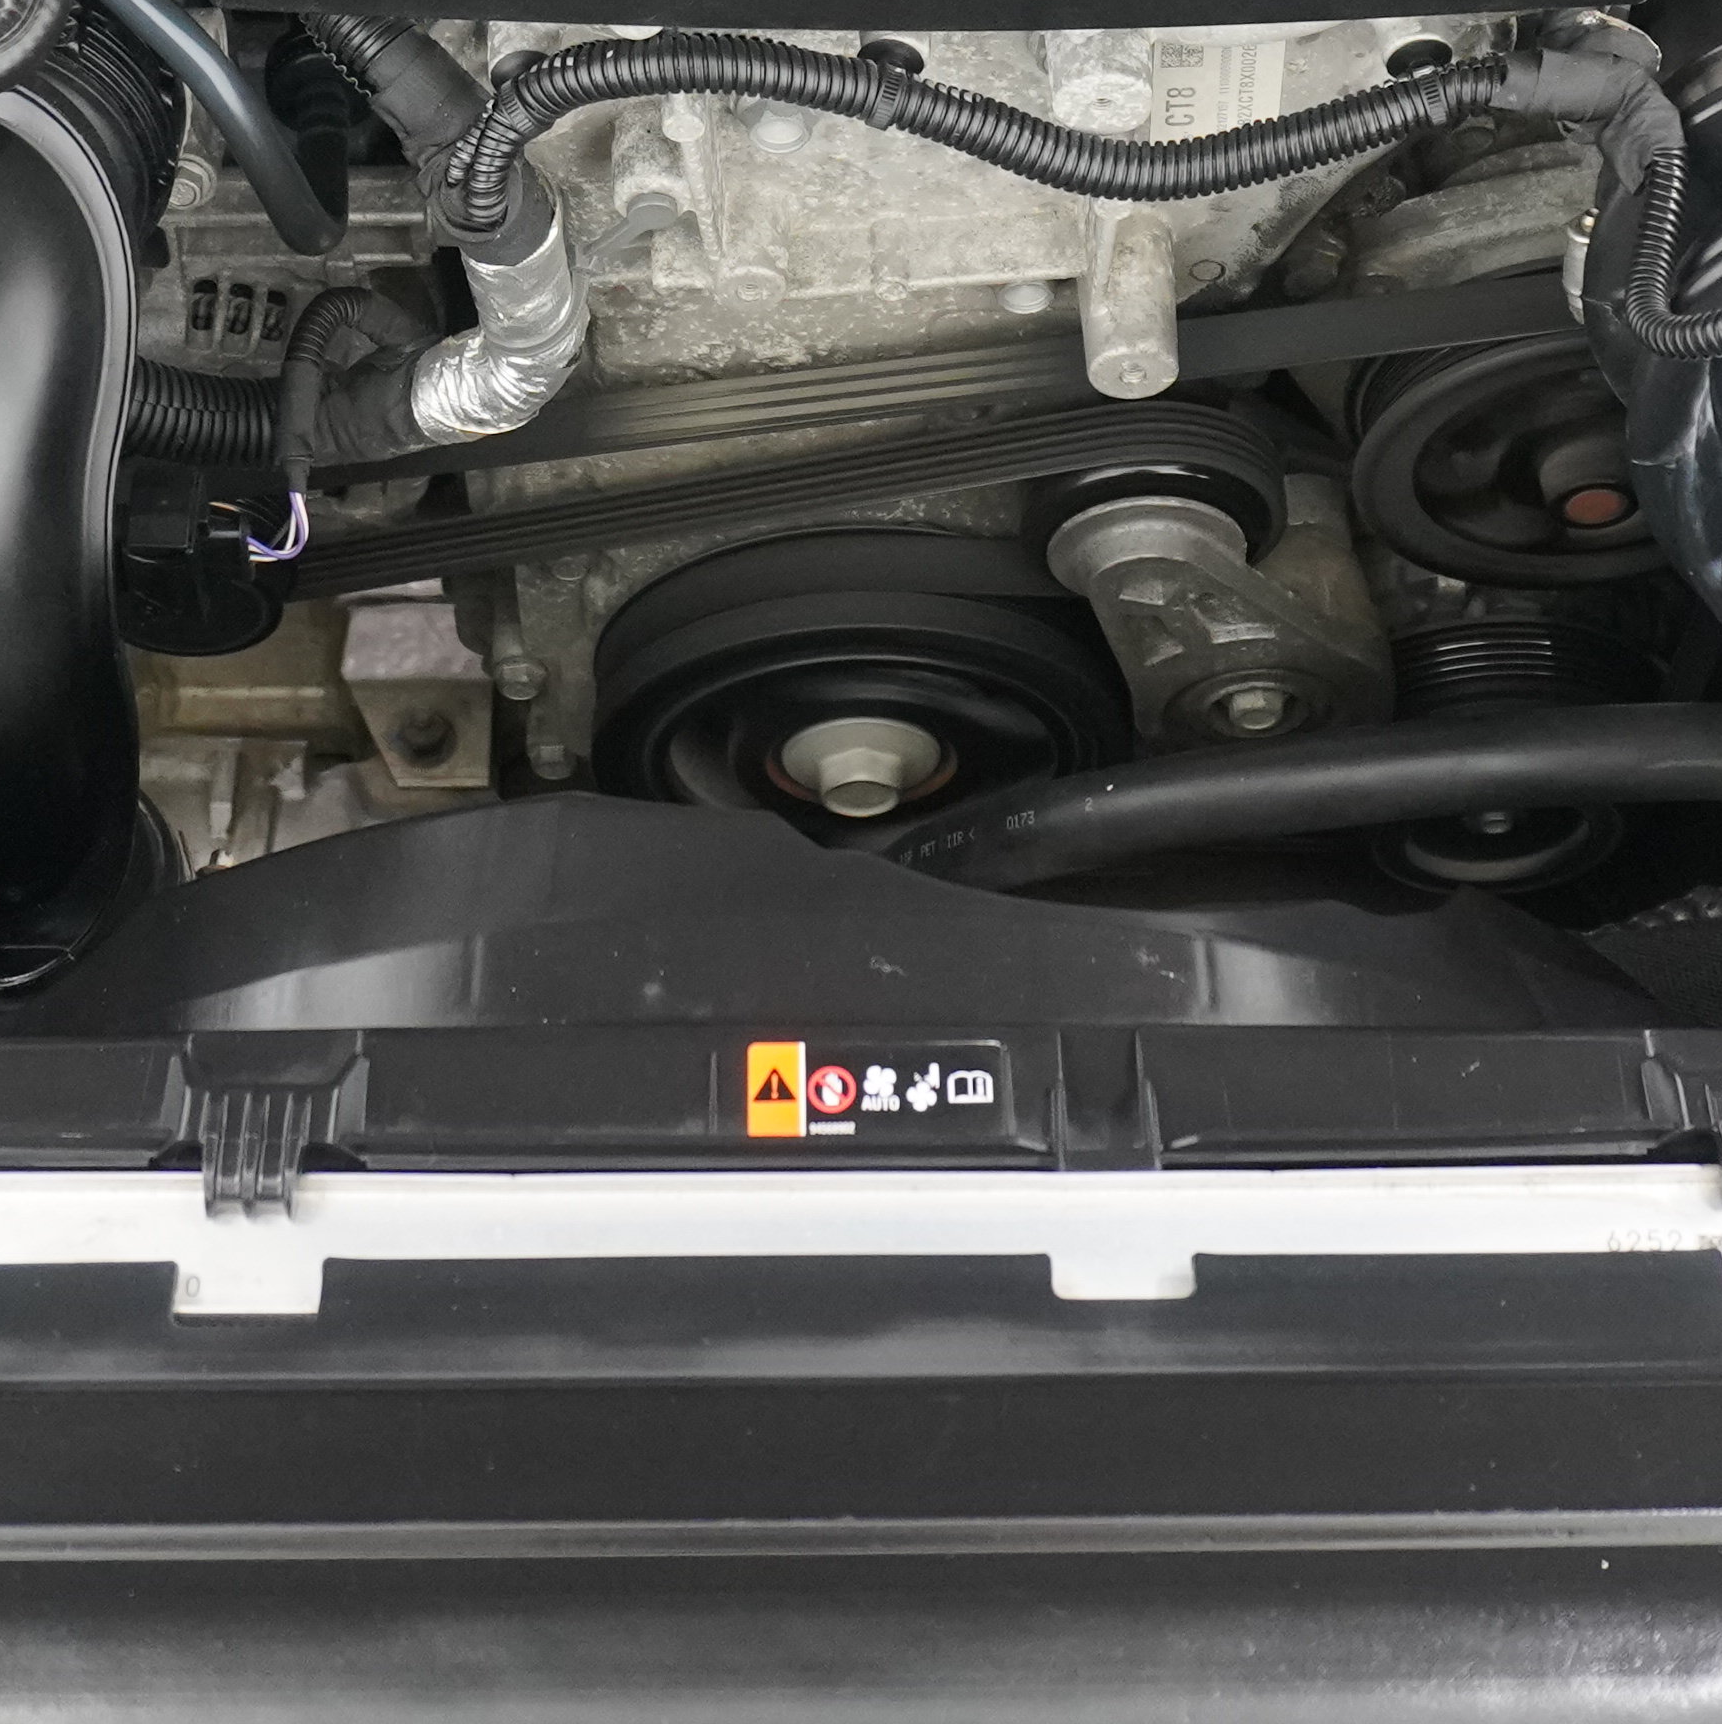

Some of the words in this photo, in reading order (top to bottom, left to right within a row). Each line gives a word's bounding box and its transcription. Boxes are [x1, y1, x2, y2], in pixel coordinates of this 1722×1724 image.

[1165, 87, 1197, 127] CT8
[1006, 810, 1036, 830] 0173
[860, 1094, 901, 1112] AUTO
[1607, 1228, 1683, 1251] 6252
